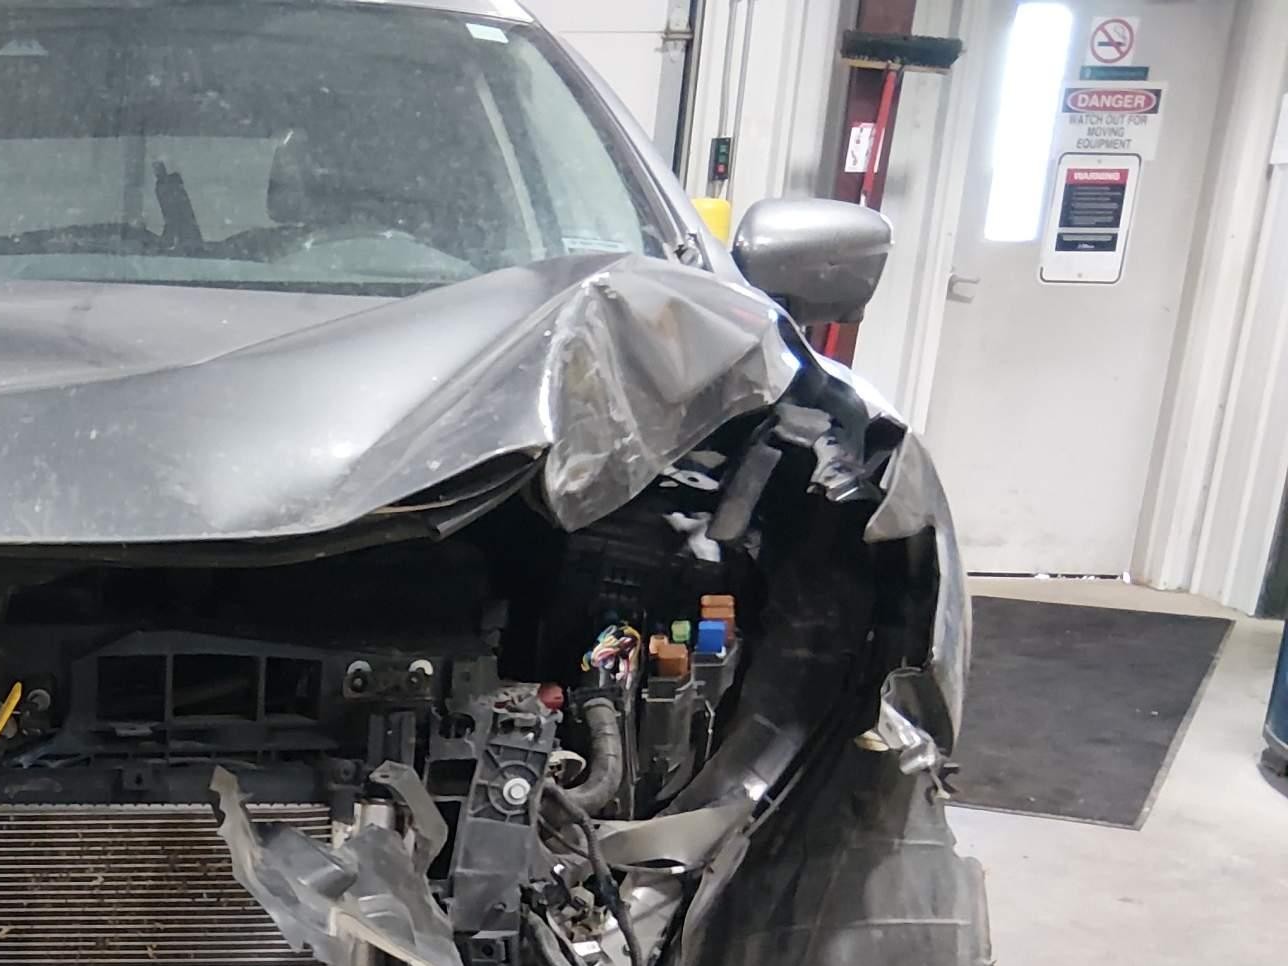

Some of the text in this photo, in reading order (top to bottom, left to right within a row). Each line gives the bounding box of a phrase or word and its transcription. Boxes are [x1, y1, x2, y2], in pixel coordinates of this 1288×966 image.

[1077, 94, 1146, 108] DANGER
[1069, 114, 1148, 126] WATCH OUT FOR
[1087, 127, 1125, 137] MOVING
[1076, 138, 1132, 149] EQUIPMENT
